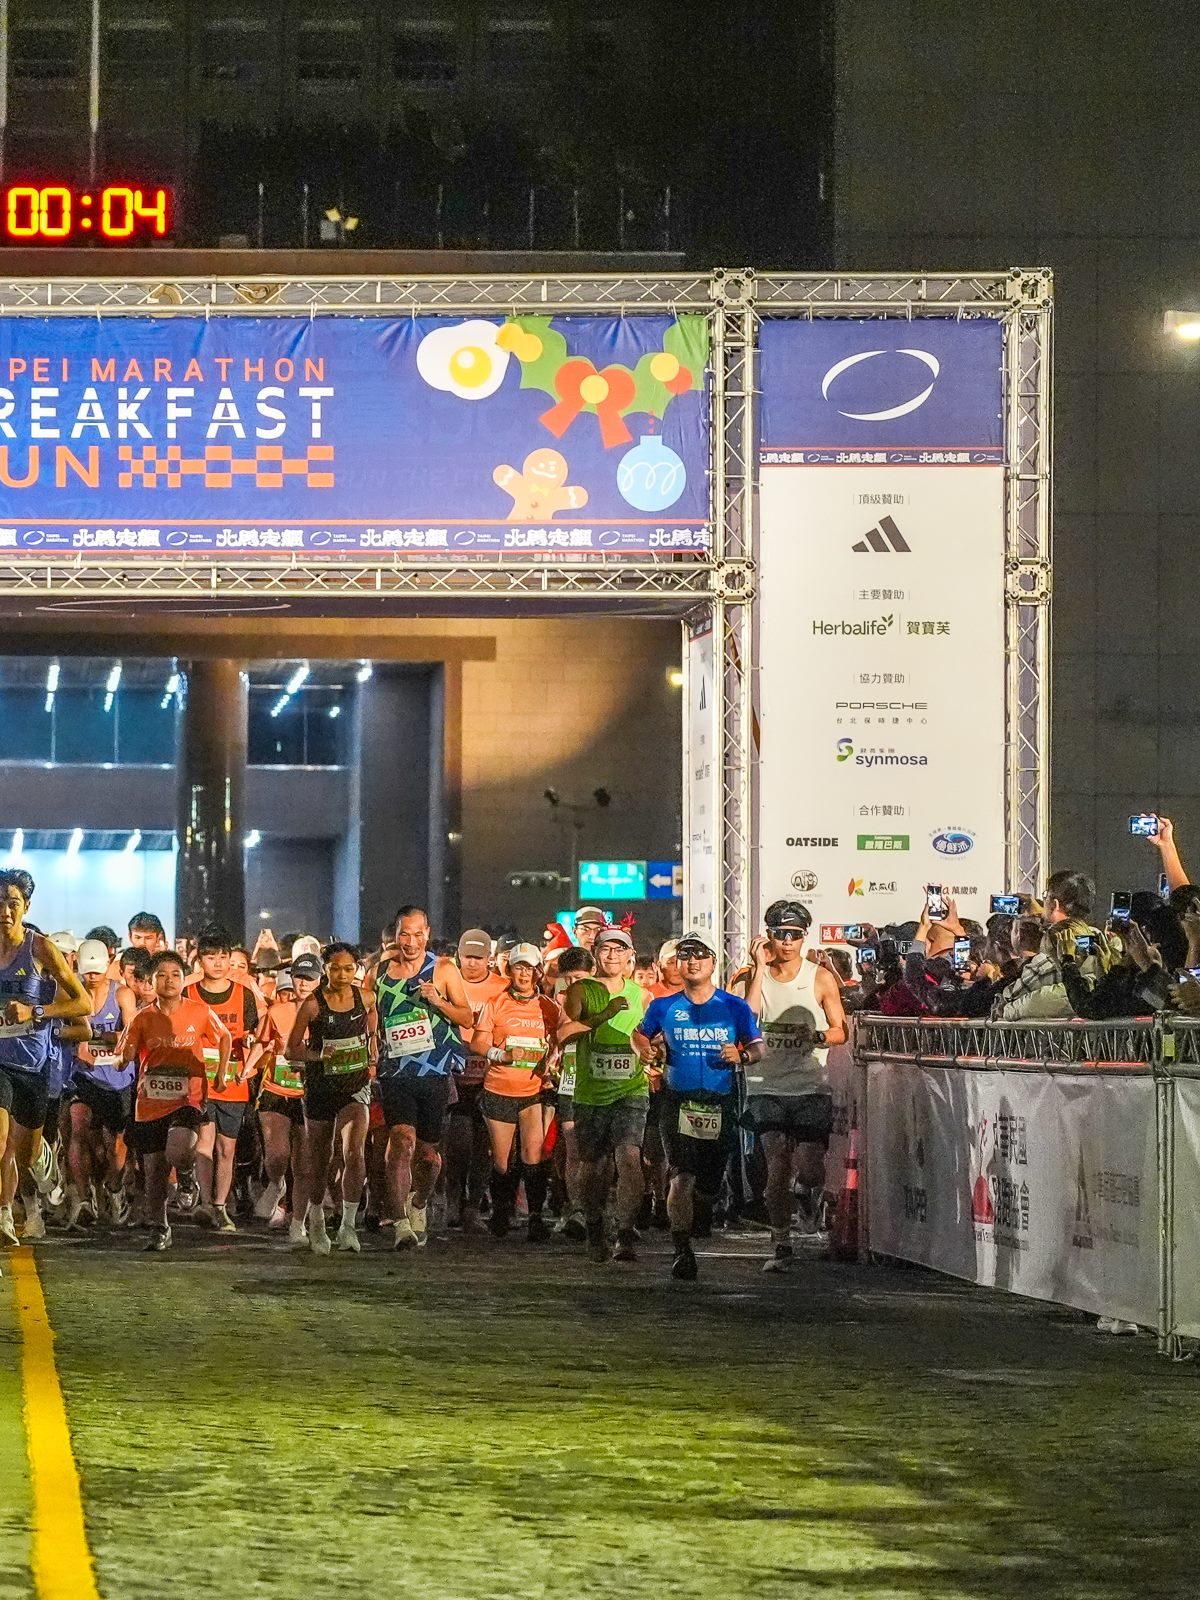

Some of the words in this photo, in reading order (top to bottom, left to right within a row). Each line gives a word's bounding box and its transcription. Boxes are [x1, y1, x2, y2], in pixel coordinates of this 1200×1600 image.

[91, 358, 326, 382] MARATHON
[858, 494, 905, 505] 頂級贊助
[858, 590, 905, 601] 主要贊助
[812, 616, 887, 636] Herbalife
[906, 620, 951, 636] 賀寶芙
[859, 673, 905, 684] 協力贊助
[835, 702, 928, 710] PORSCHE
[855, 753, 928, 767] synmosa
[859, 805, 905, 817] 合作贊助
[785, 837, 839, 847] OATSIDE
[391, 1025, 427, 1041] 5293
[596, 1058, 630, 1070] 5168
[150, 1079, 183, 1091] 6368
